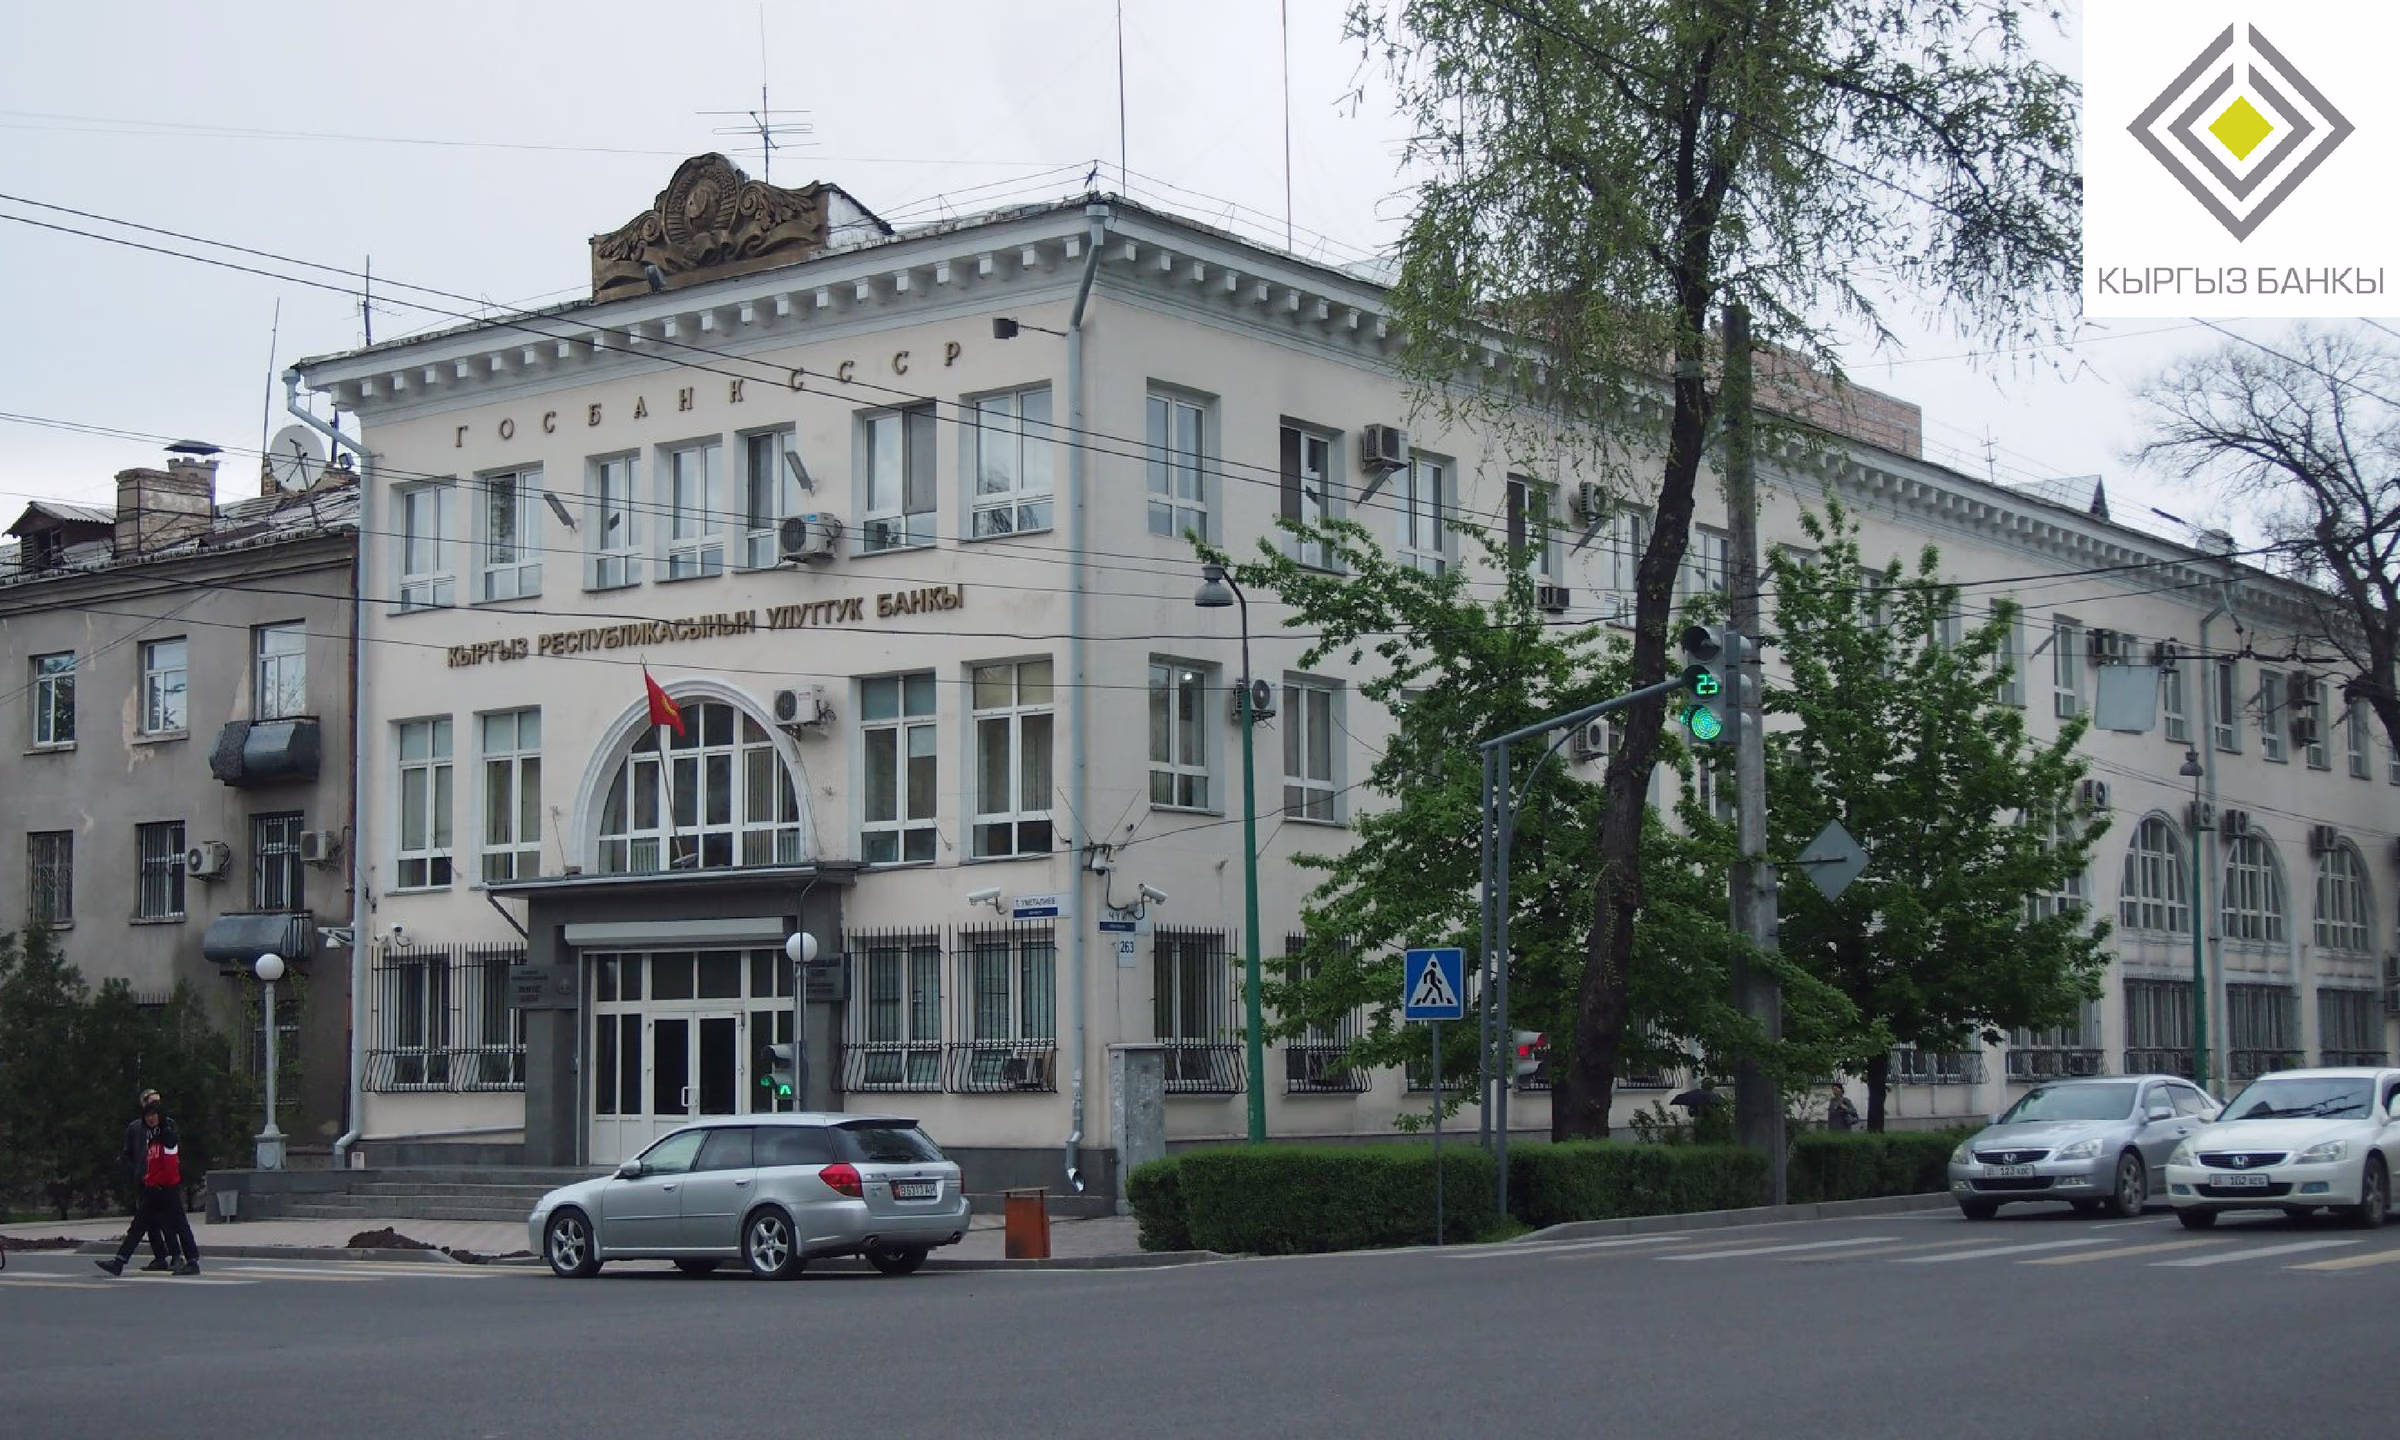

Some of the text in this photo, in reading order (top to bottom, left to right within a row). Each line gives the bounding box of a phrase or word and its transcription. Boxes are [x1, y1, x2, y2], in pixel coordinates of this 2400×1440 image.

[455, 340, 961, 448] ГОСБАНК СССР
[447, 637, 529, 668] КЫРГЫЗ
[876, 584, 964, 618] БАНКЫ
[1120, 940, 1134, 953] 263
